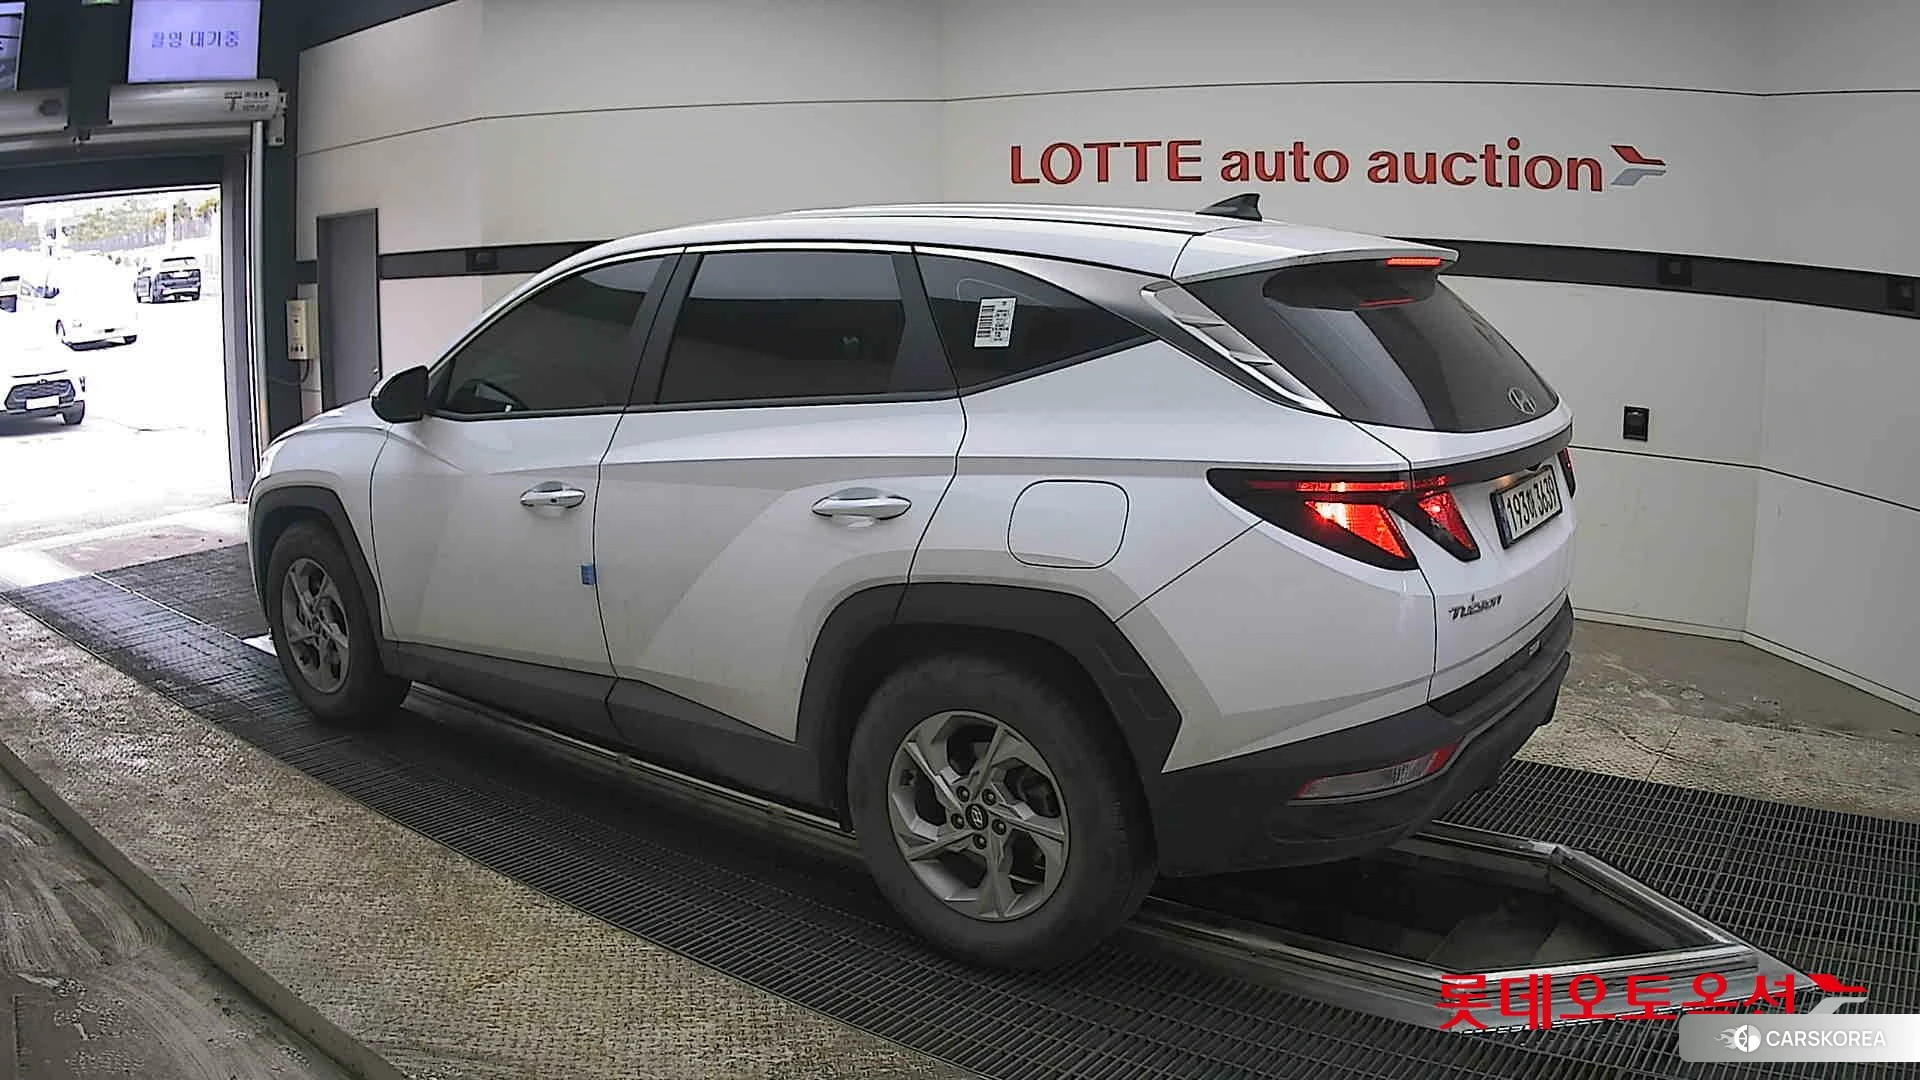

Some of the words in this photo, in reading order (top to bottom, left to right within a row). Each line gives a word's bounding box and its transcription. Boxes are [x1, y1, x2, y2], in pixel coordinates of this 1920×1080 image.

[190, 30, 240, 48] 대기중
[1011, 140, 1202, 185] LOTTE
[1220, 142, 1351, 184] auto
[1367, 137, 1603, 192] auction
